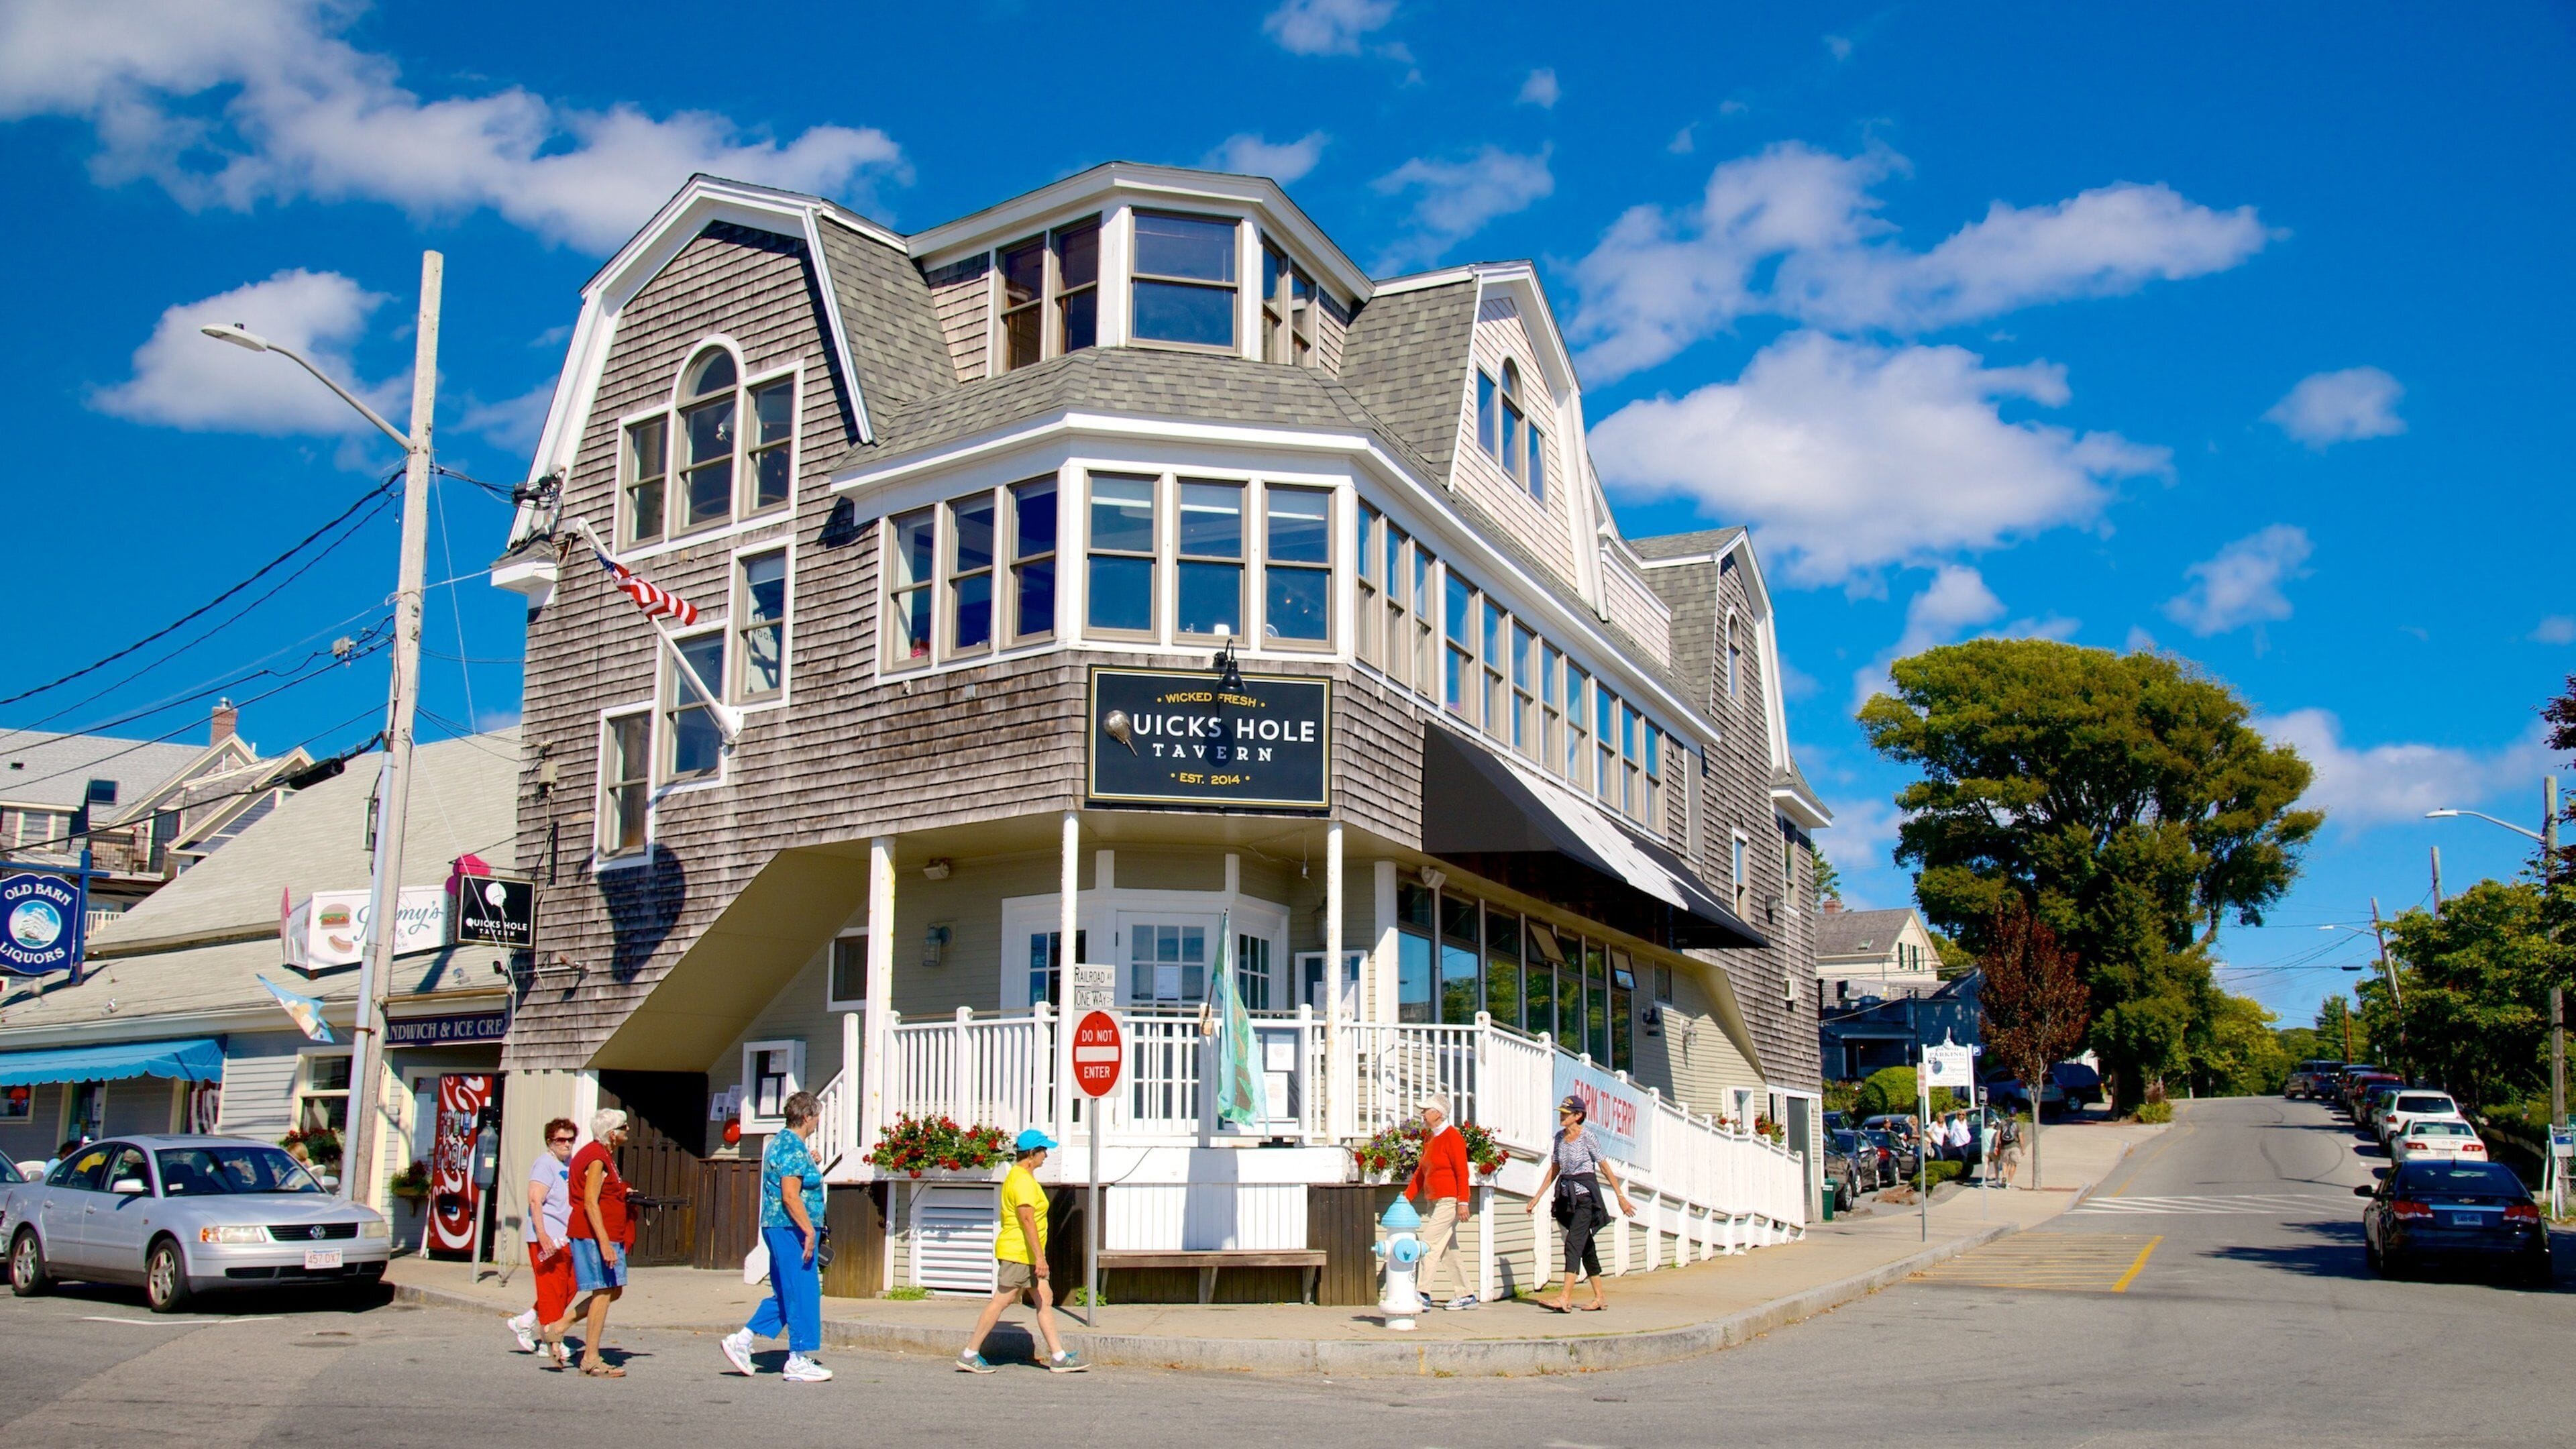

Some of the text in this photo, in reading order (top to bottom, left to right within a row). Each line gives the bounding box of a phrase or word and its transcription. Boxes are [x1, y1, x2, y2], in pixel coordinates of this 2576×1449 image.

[1165, 692, 1257, 708] WICKED FRESH
[1236, 718, 1316, 743] HOLE
[1152, 743, 1273, 762] TAVERN
[1179, 772, 1240, 785] EST. 2014
[5, 883, 74, 906] OLD BARN
[504, 922, 527, 931] HOLE
[0, 941, 66, 964] LIQUORS
[1075, 967, 1105, 983] RAILROAD
[1076, 990, 1106, 1006] ONE WAY
[386, 1018, 503, 1040] NDWICH & ICE CRE
[1082, 1030, 1113, 1042] DO NOT
[1084, 1066, 1111, 1079] ENTER
[1601, 1090, 1610, 1128] TO
[1611, 1096, 1637, 1138] FERRY
[307, 1253, 323, 1265] 457
